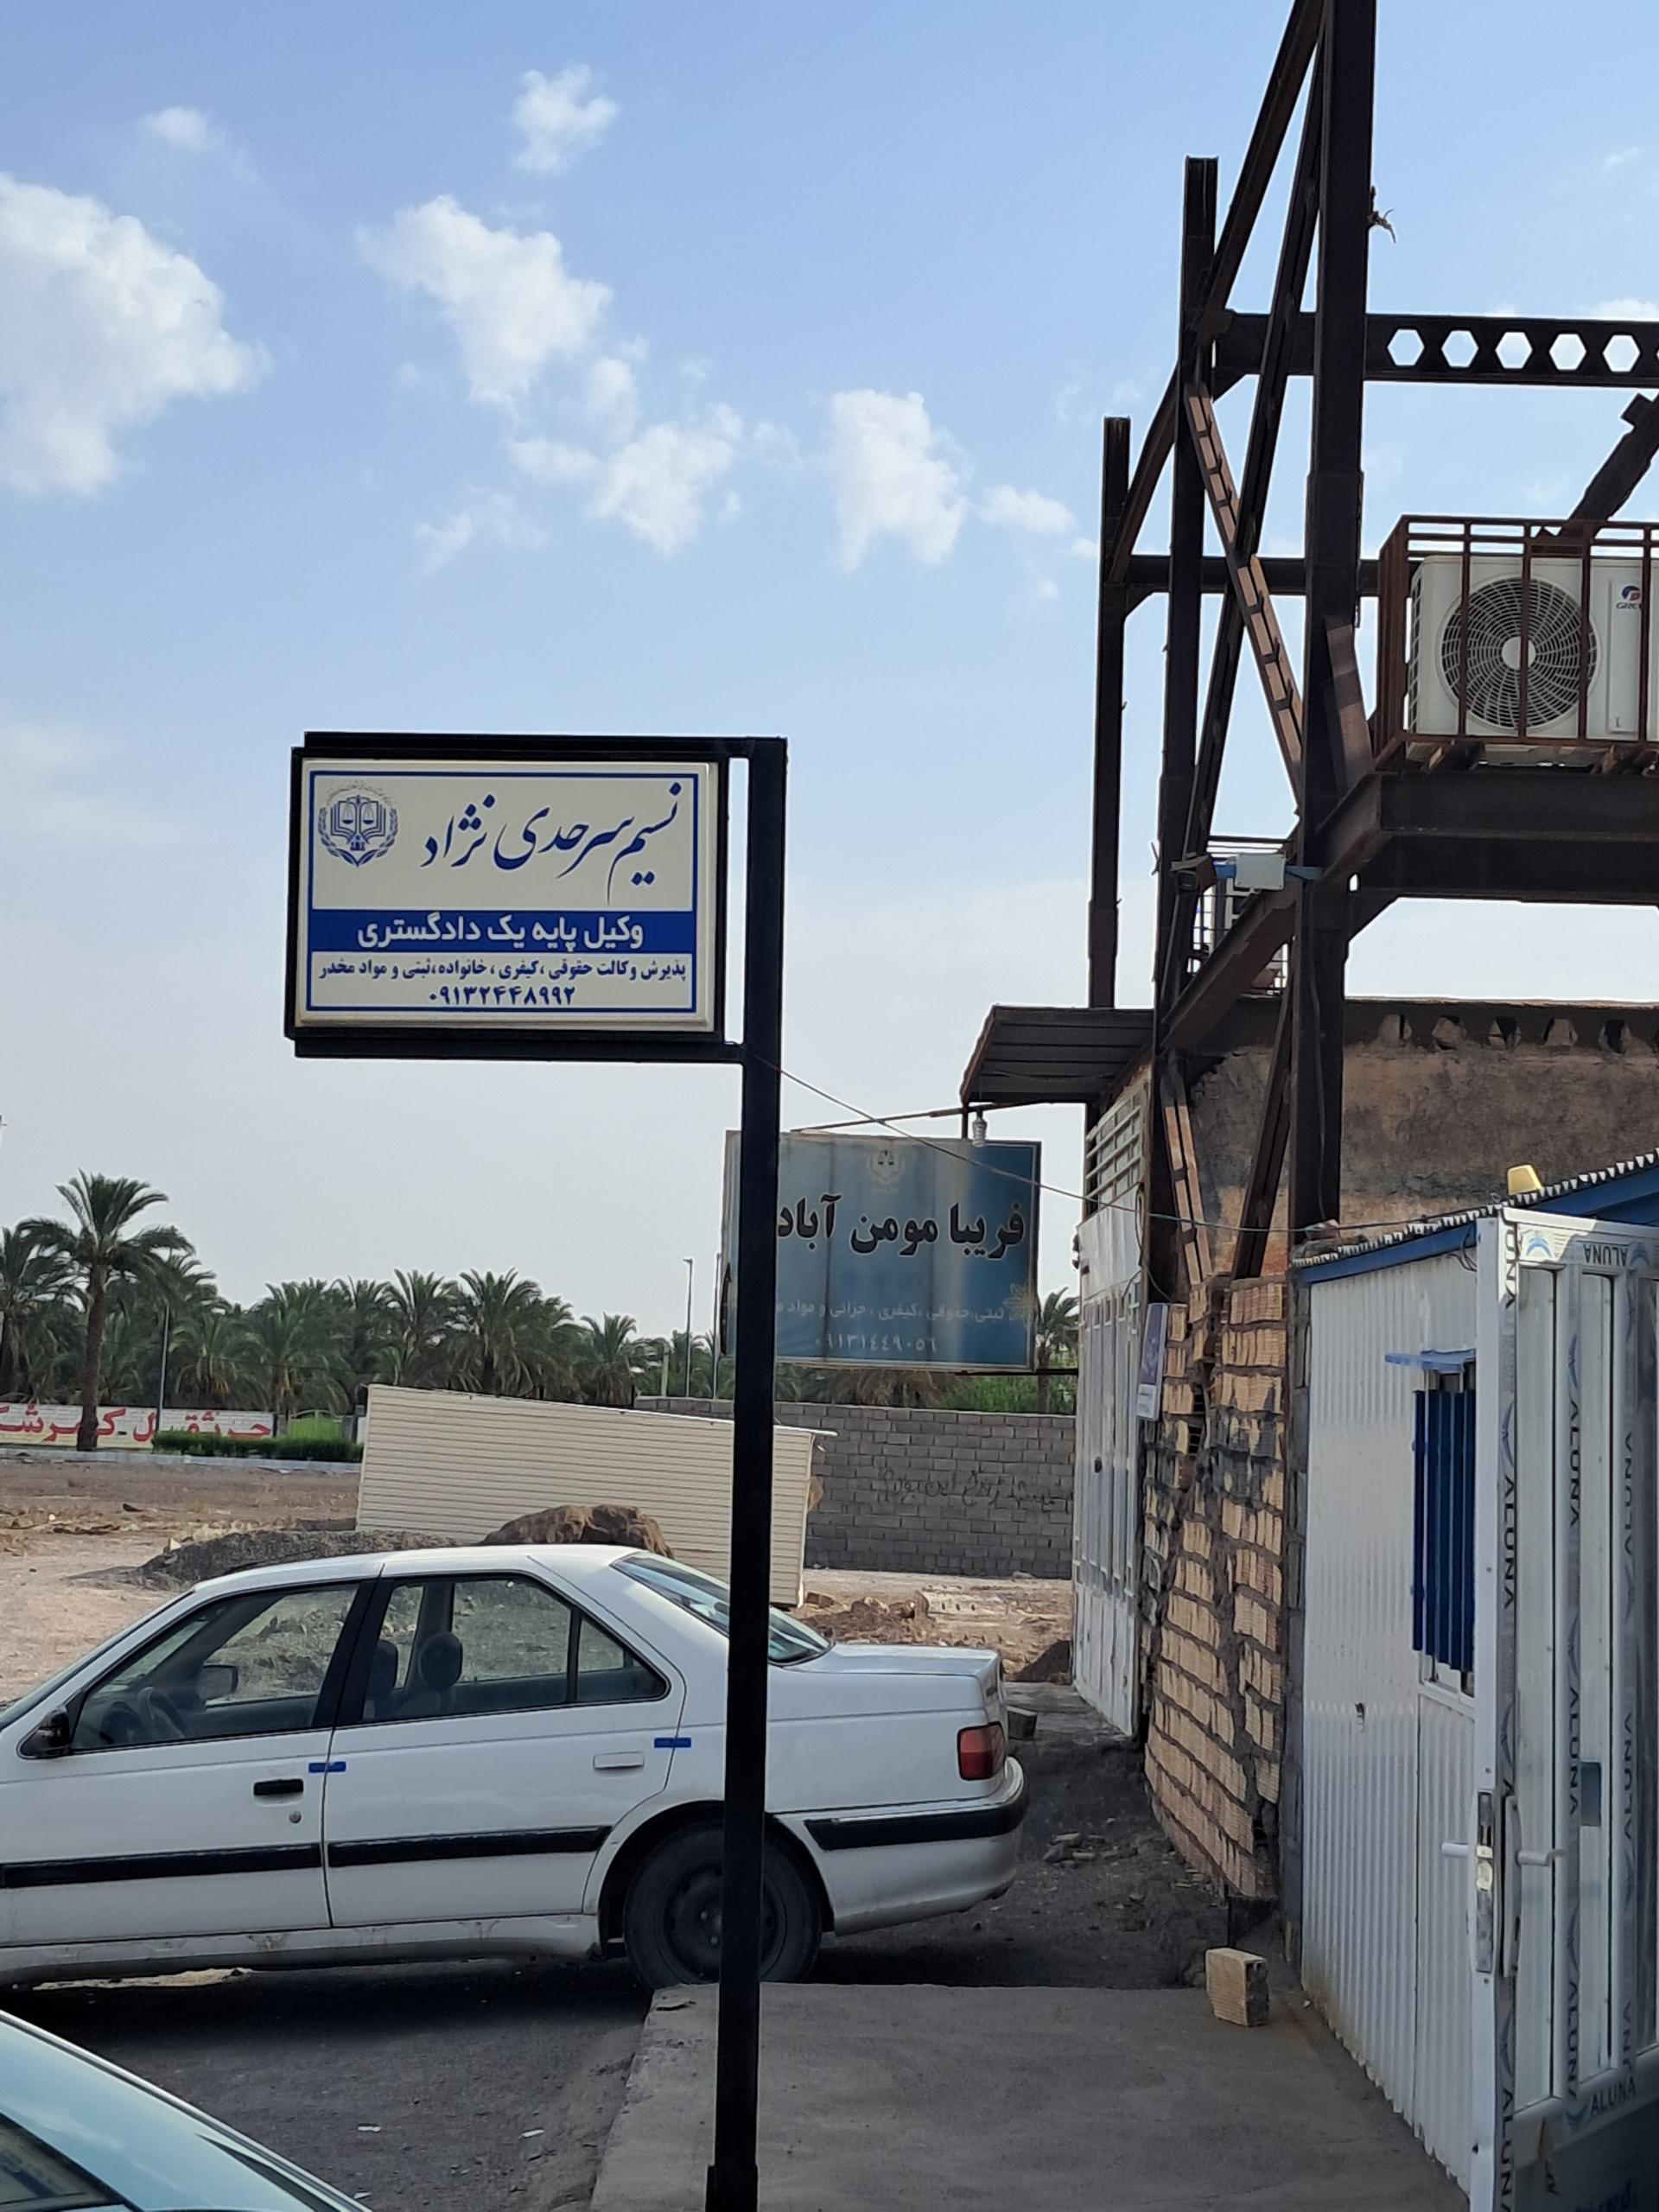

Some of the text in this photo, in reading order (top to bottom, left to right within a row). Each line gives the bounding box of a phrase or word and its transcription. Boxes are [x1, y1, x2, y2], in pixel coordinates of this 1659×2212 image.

[420, 781, 682, 906] نسیم سرحدی نژاد
[358, 912, 644, 952] وکیل پایه یک دادگستری
[319, 958, 355, 979] مخدر
[359, 958, 387, 980] مواد
[391, 965, 399, 979] و
[549, 958, 593, 980] حقوقی
[596, 958, 637, 981] وکالت
[640, 958, 686, 982] پذیرش
[429, 986, 575, 1005] ۰۹۱۳۲۴۴۸۹۹۲
[778, 1193, 1025, 1259] فریبا مومن آباد
[1583, 1244, 1629, 1267] ALUNA
[1569, 1399, 1580, 1527] ALUNA
[1503, 1473, 1516, 1610] ALUNA
[1569, 1686, 1580, 1815] ALUNA
[1590, 2075, 1637, 2114] ALUNA
